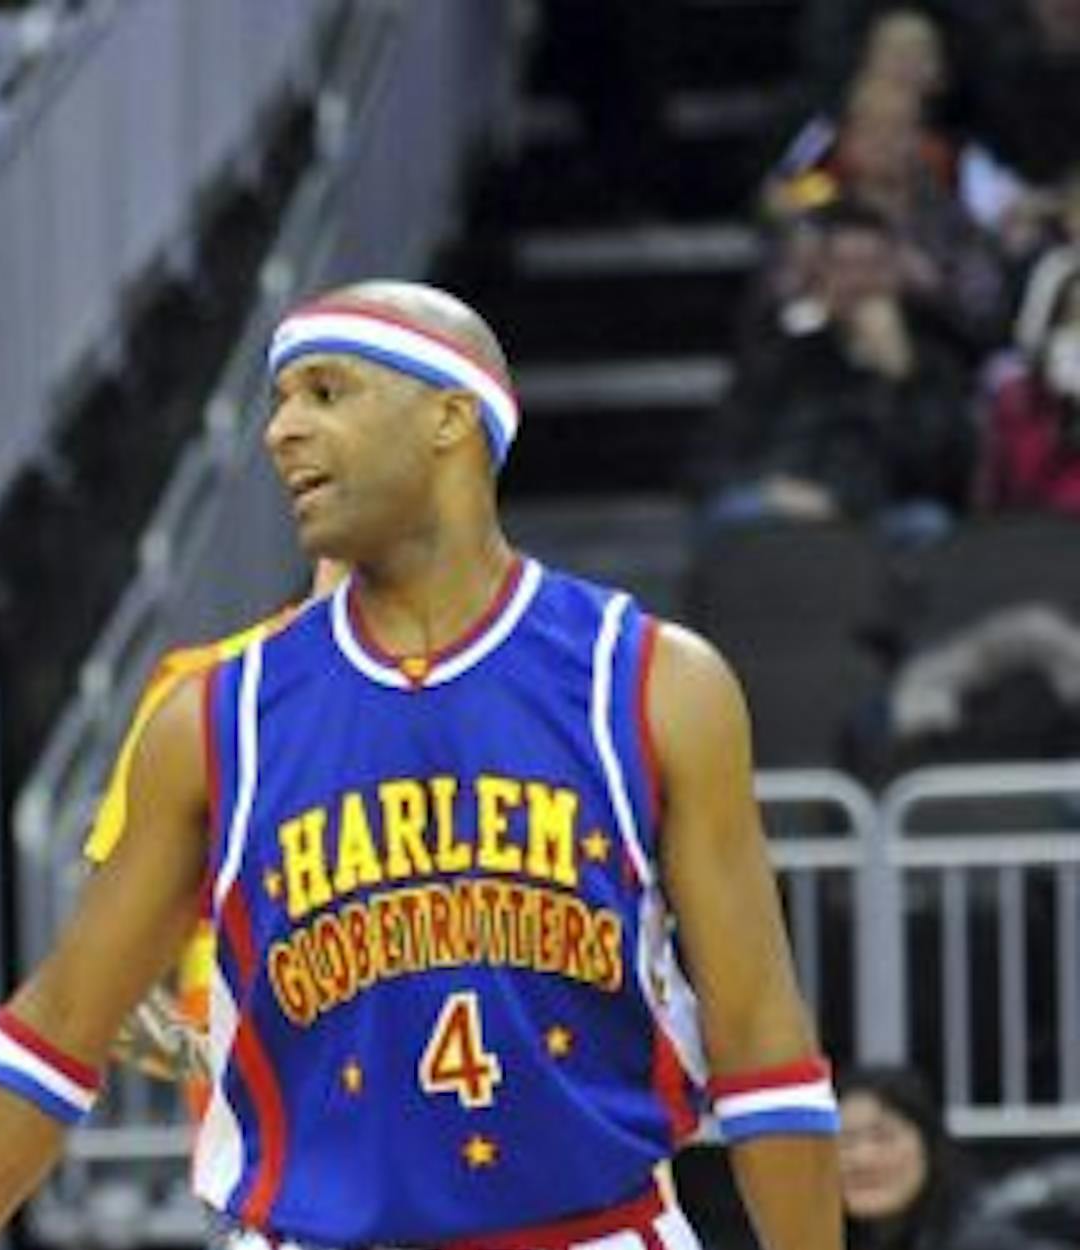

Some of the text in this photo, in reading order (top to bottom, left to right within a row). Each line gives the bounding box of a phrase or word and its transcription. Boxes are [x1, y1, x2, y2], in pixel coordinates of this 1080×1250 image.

[278, 775, 581, 919] HARLEM
[269, 878, 622, 1027] GLOBETROTTERS
[421, 990, 502, 1107] 4
